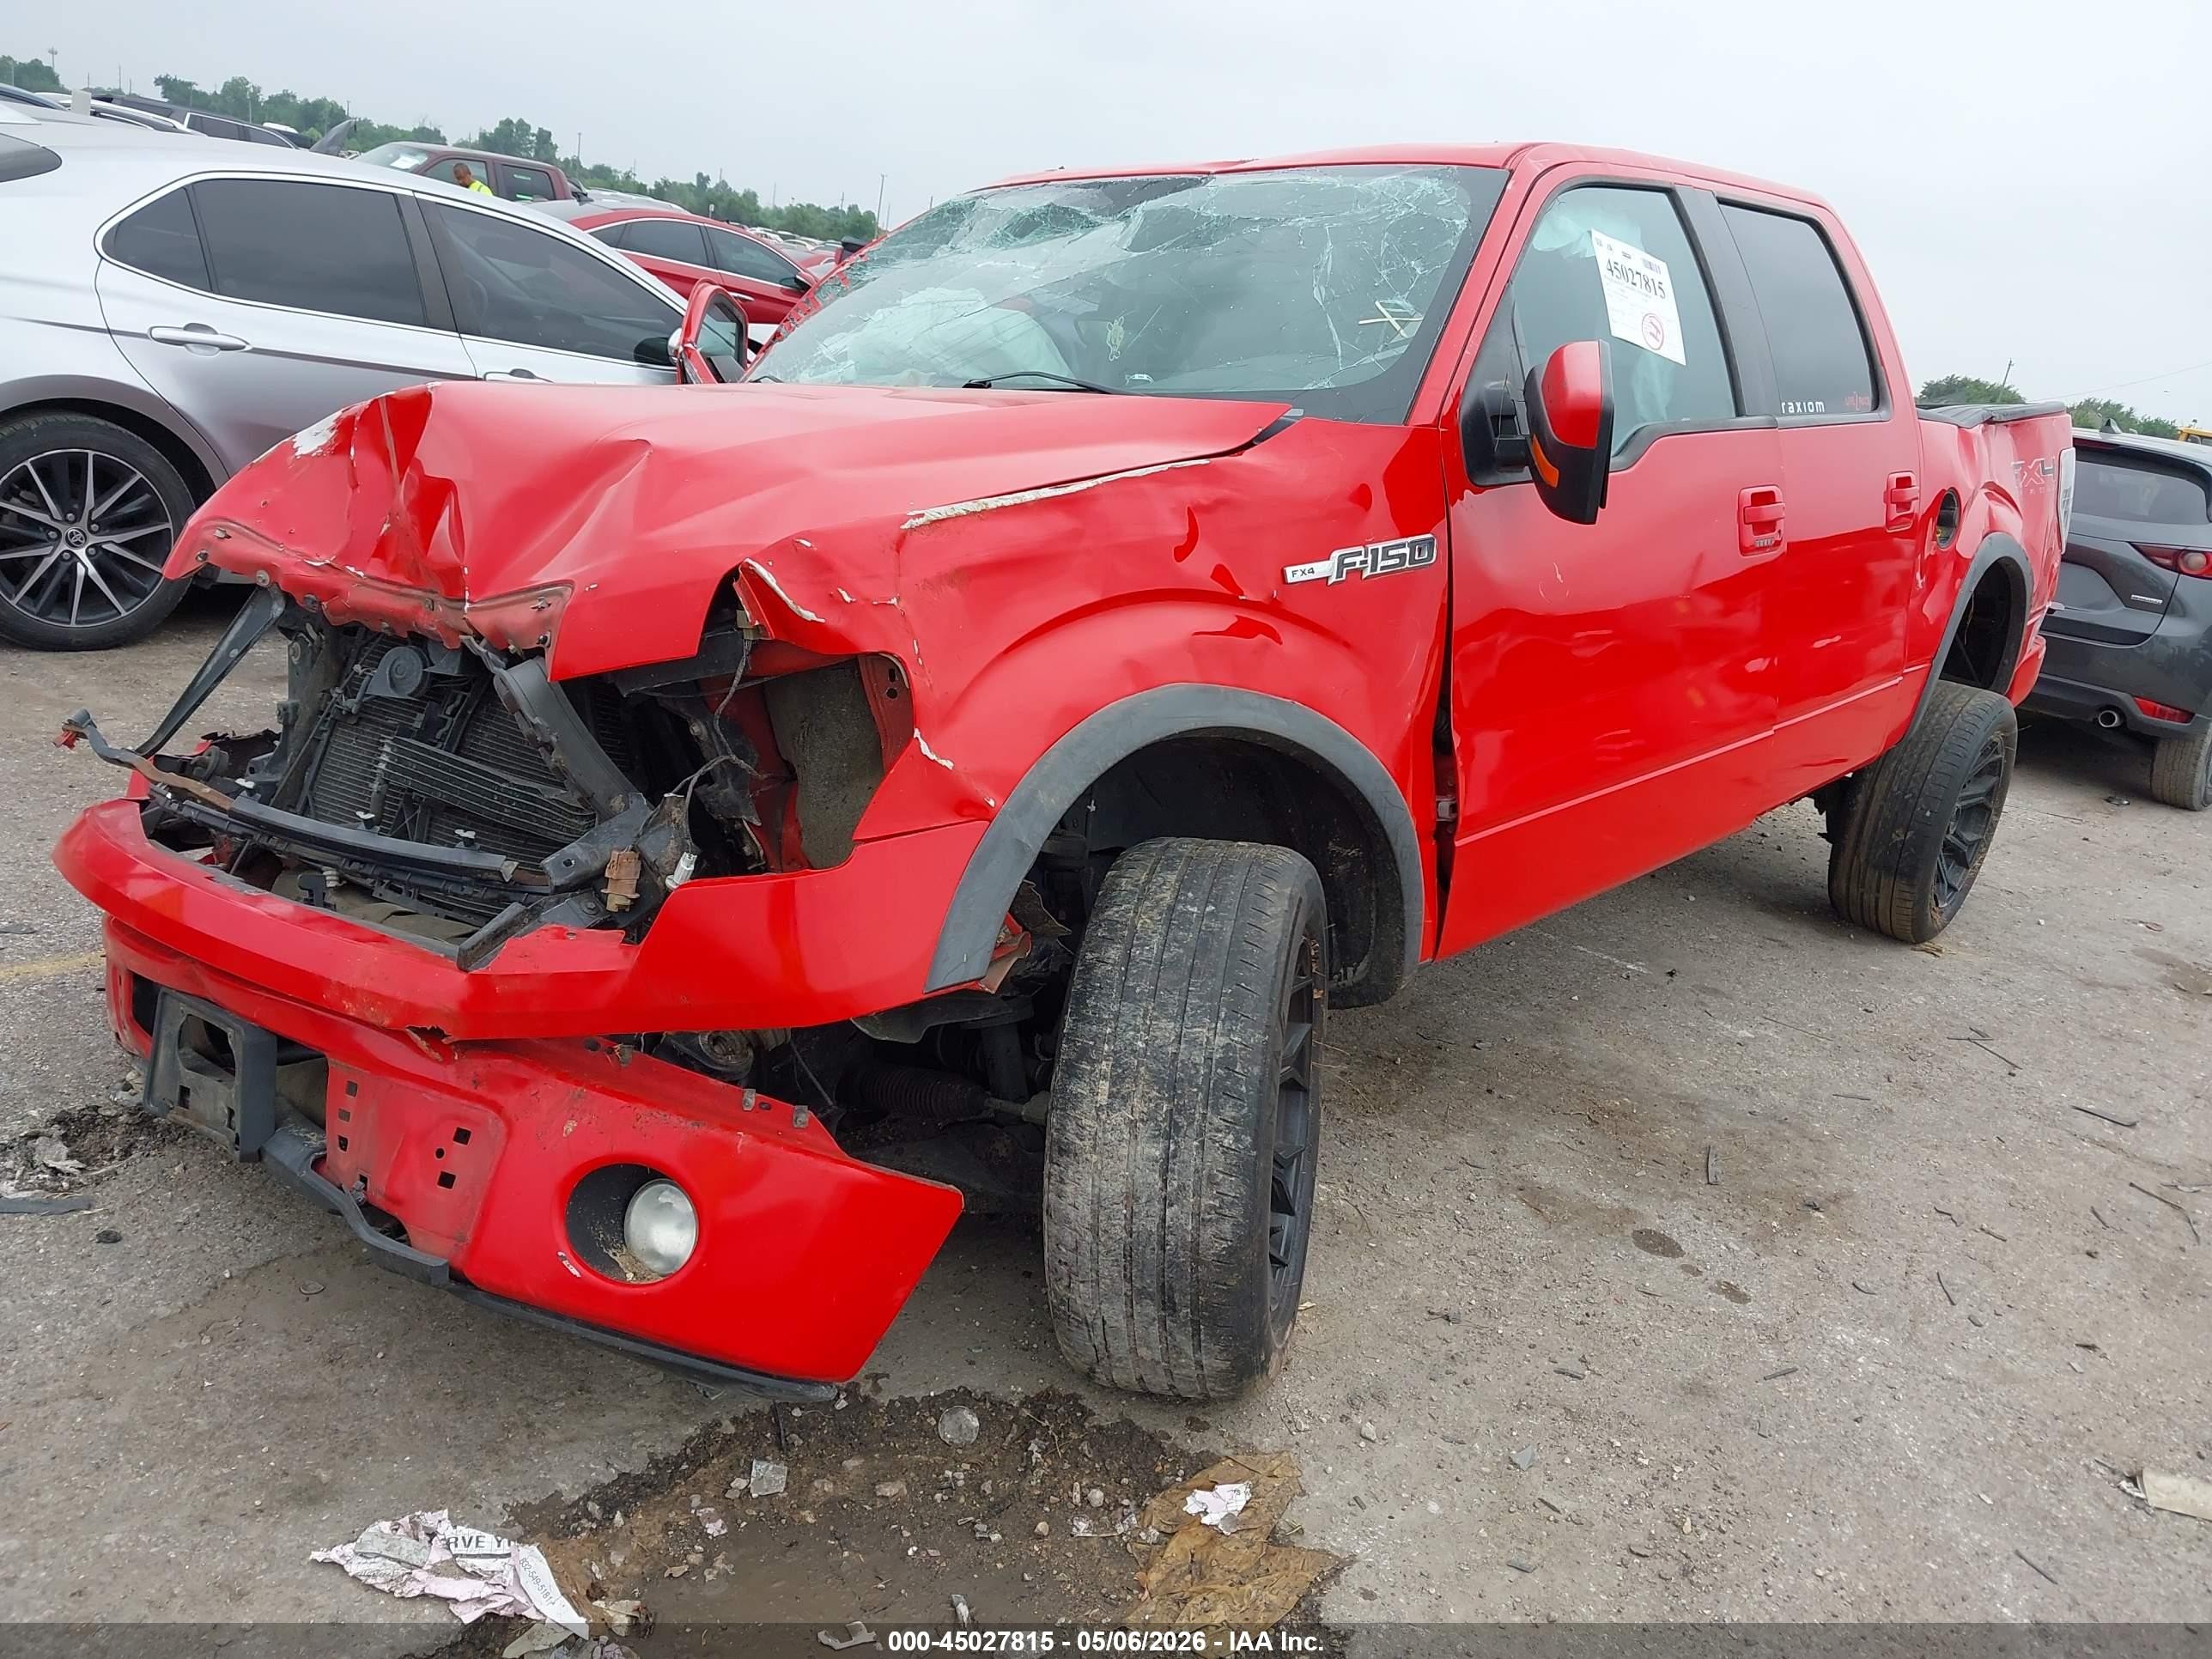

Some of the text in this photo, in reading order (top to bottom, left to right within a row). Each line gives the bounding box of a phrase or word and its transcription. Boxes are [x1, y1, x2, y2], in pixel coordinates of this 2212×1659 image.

[1606, 258, 1666, 300] 45027815
[1781, 400, 1826, 414] raxiom
[2011, 454, 2056, 488] FX4
[1291, 534, 1437, 584] FX4 F-150
